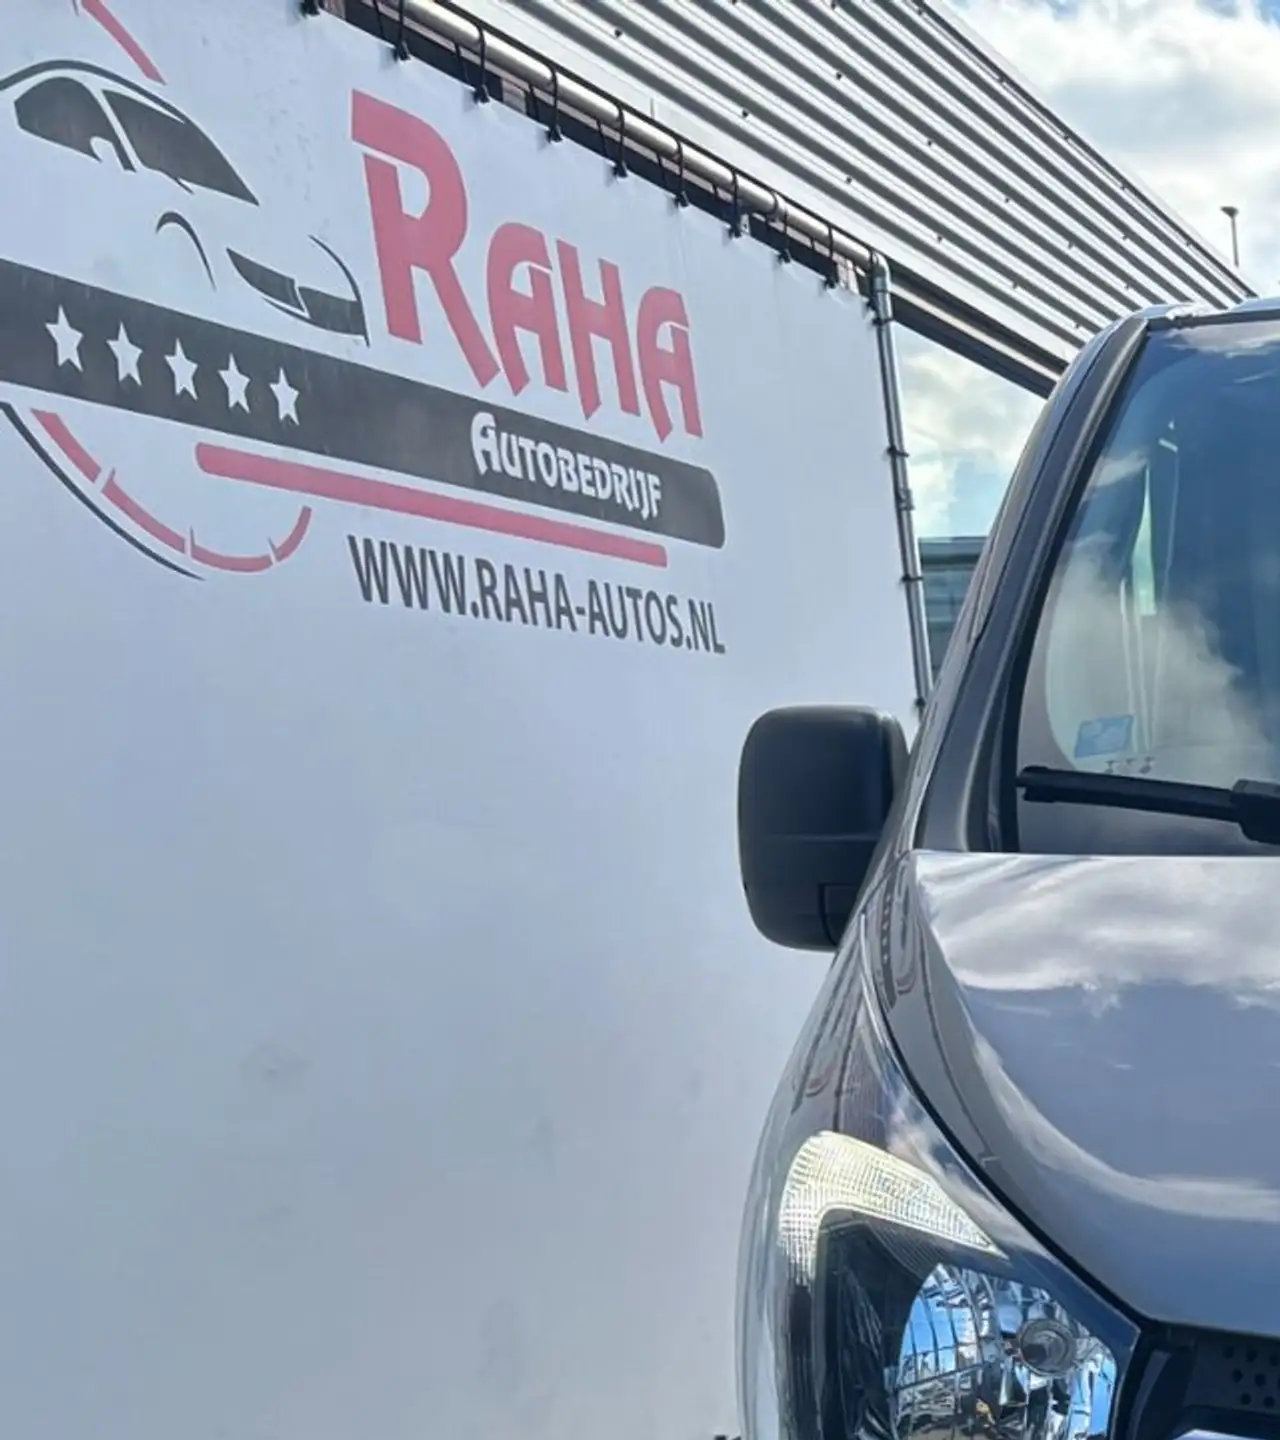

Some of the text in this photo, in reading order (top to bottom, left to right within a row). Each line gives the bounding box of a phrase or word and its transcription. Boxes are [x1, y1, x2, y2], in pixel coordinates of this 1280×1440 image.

[351, 88, 704, 444] RAHA
[470, 411, 662, 521] AUTOBEDRIJF
[347, 534, 726, 656] WWW.RAHA-AUTOS.NL
